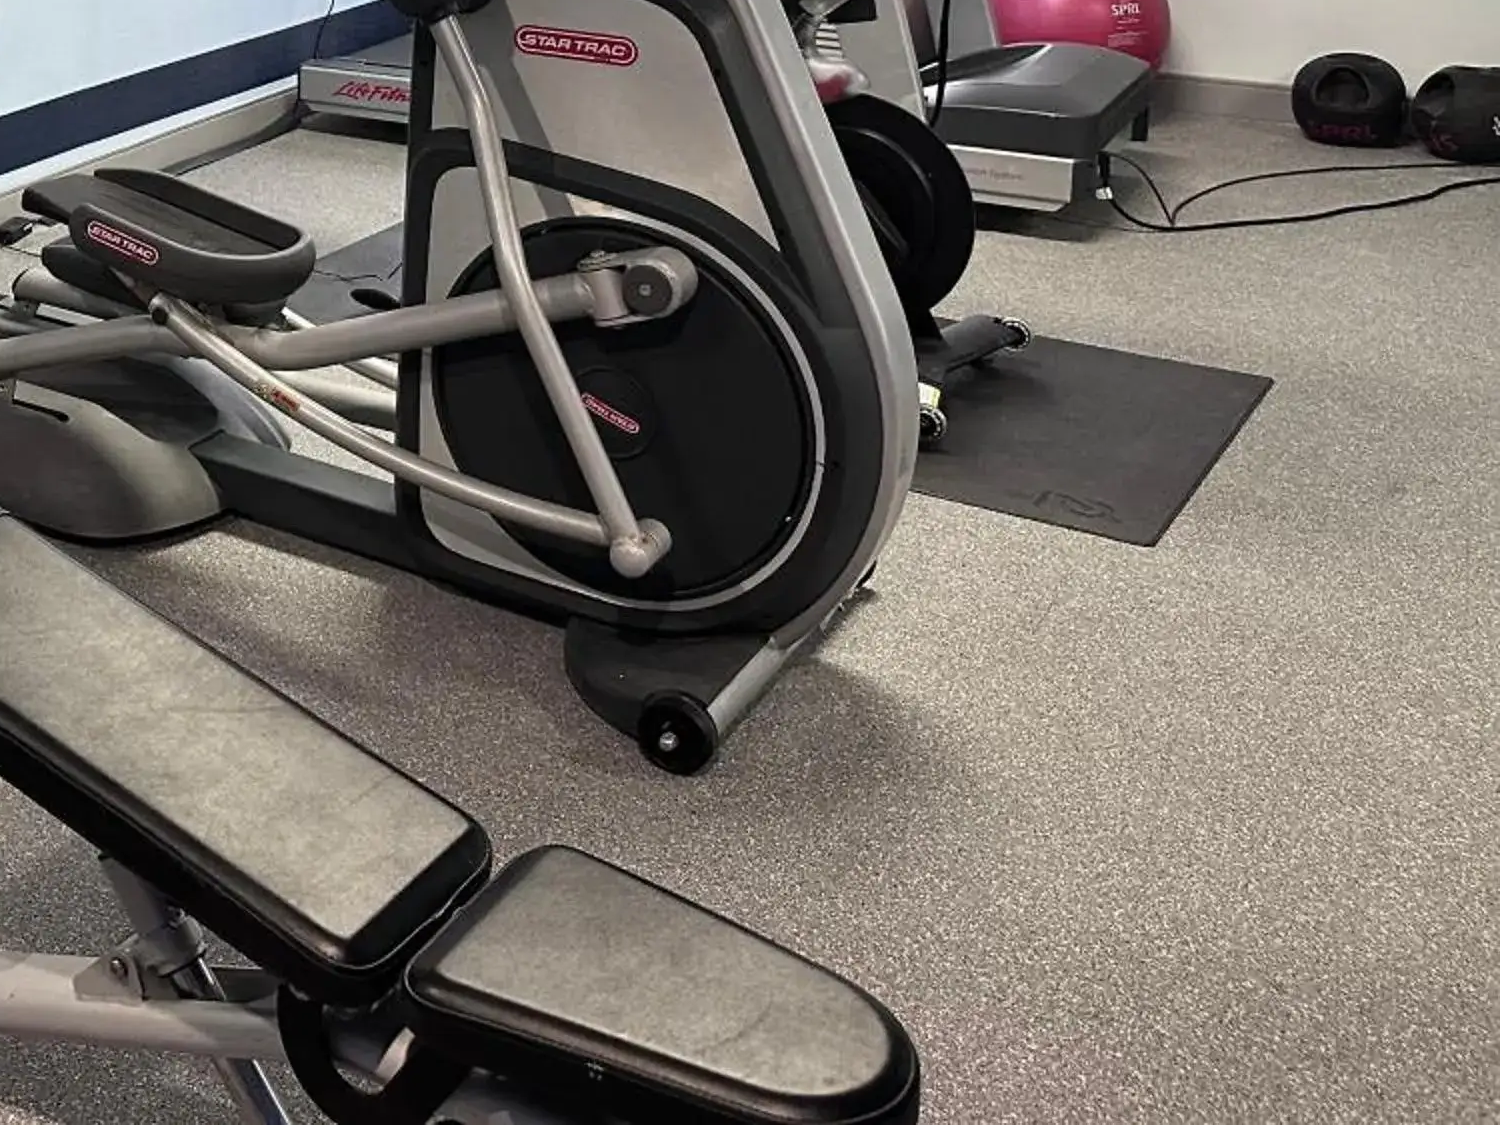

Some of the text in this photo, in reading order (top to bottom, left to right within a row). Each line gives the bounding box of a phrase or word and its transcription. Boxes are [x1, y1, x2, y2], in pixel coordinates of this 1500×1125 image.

[1110, 2, 1141, 17] SPRI
[521, 33, 628, 57] STAR TRAC
[91, 225, 154, 260] STAR TRAC
